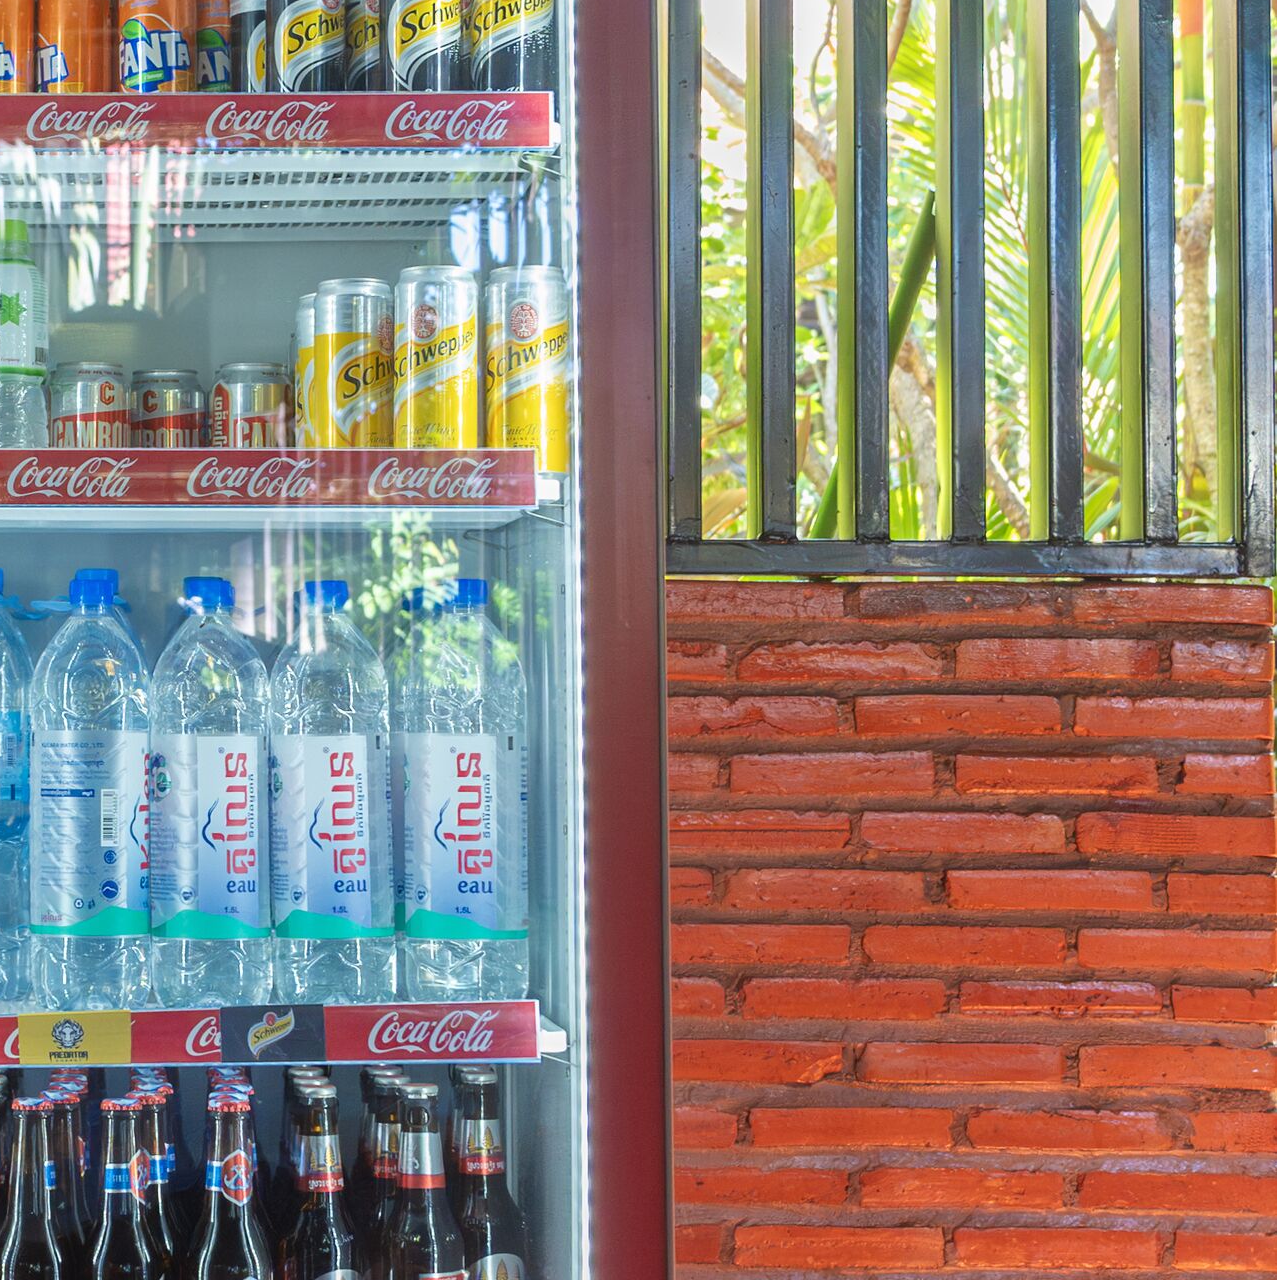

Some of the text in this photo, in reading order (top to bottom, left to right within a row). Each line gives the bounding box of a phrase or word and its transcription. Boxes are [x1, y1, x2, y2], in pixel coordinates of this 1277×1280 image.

[26, 101, 156, 142] Coca-Cola
[205, 101, 335, 141] Coca-Cola
[384, 100, 515, 141] Coca-Cola
[6, 456, 138, 498] Coca-Cola
[187, 456, 317, 498] Coca-Cola
[368, 456, 499, 499] Coca-Cola
[227, 879, 256, 893] eau
[334, 879, 367, 893] eau
[458, 880, 493, 894] eau
[368, 1010, 499, 1054] Coca-Cola
[49, 1051, 88, 1061] PREDATOR
